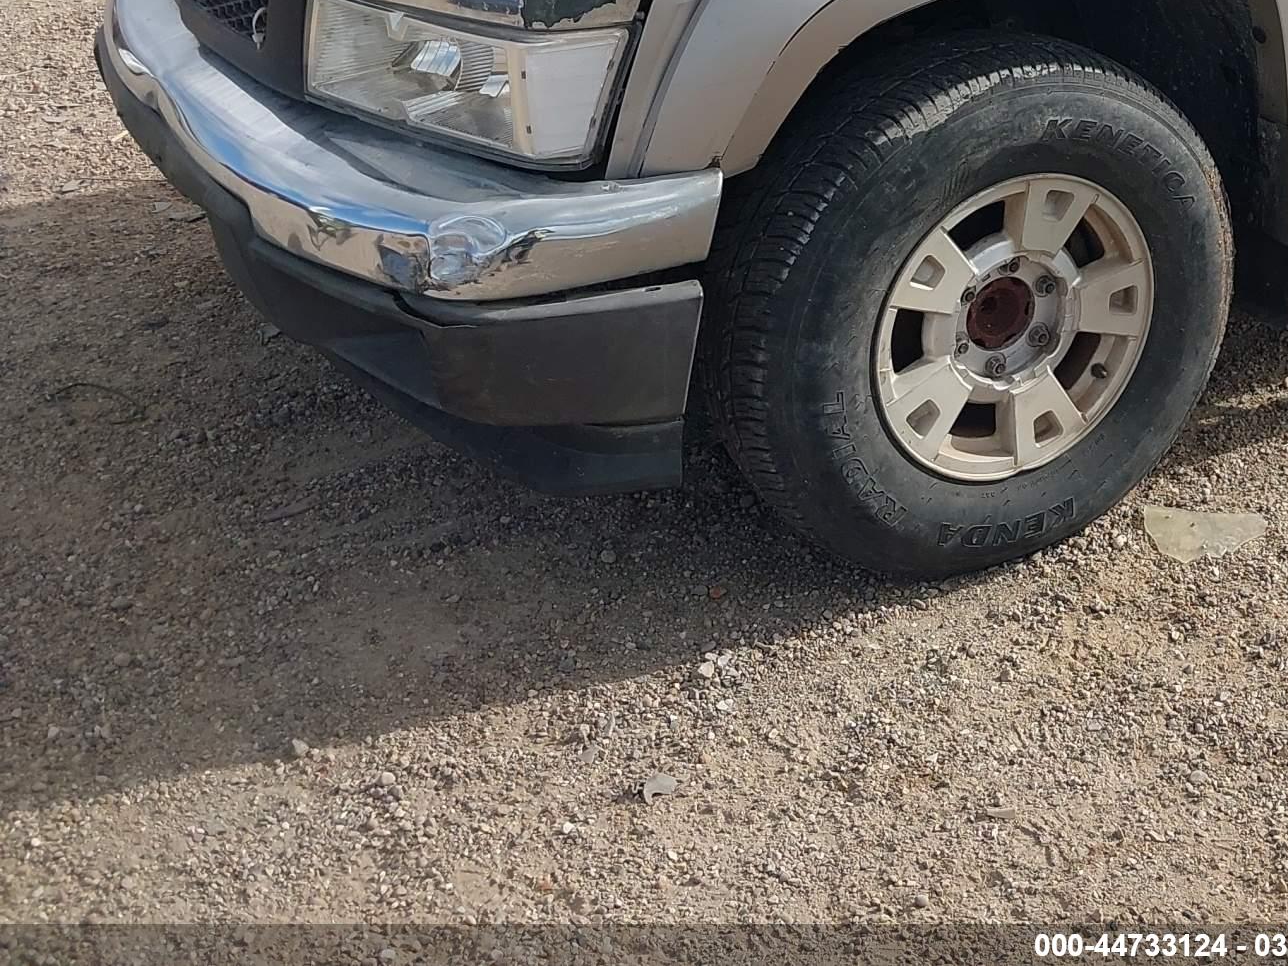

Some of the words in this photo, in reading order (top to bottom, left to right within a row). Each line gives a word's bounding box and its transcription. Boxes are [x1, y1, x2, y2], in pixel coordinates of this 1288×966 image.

[1039, 117, 1196, 216] KENETICA
[822, 389, 908, 527] RADIAL
[936, 496, 1076, 548] KENDA
